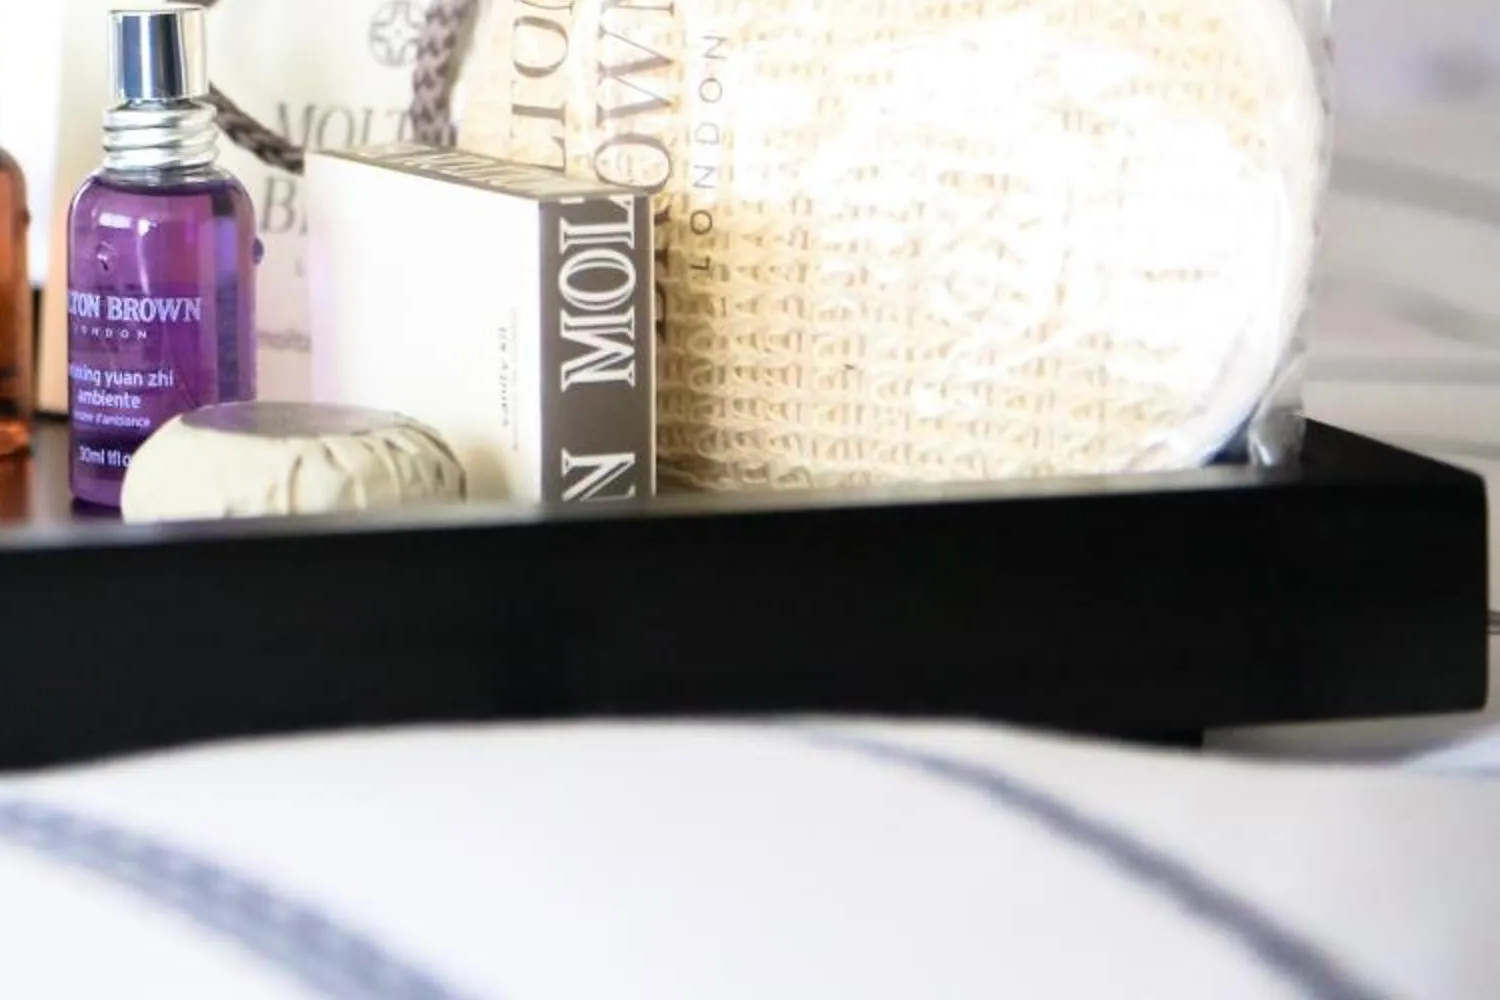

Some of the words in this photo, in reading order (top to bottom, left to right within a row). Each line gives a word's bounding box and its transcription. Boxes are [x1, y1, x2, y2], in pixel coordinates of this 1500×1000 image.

[690, 34, 729, 272] LONDON
[106, 295, 203, 323] BROWN
[557, 196, 636, 393] MOL
[103, 370, 144, 389] yuan
[147, 368, 175, 388] zhi
